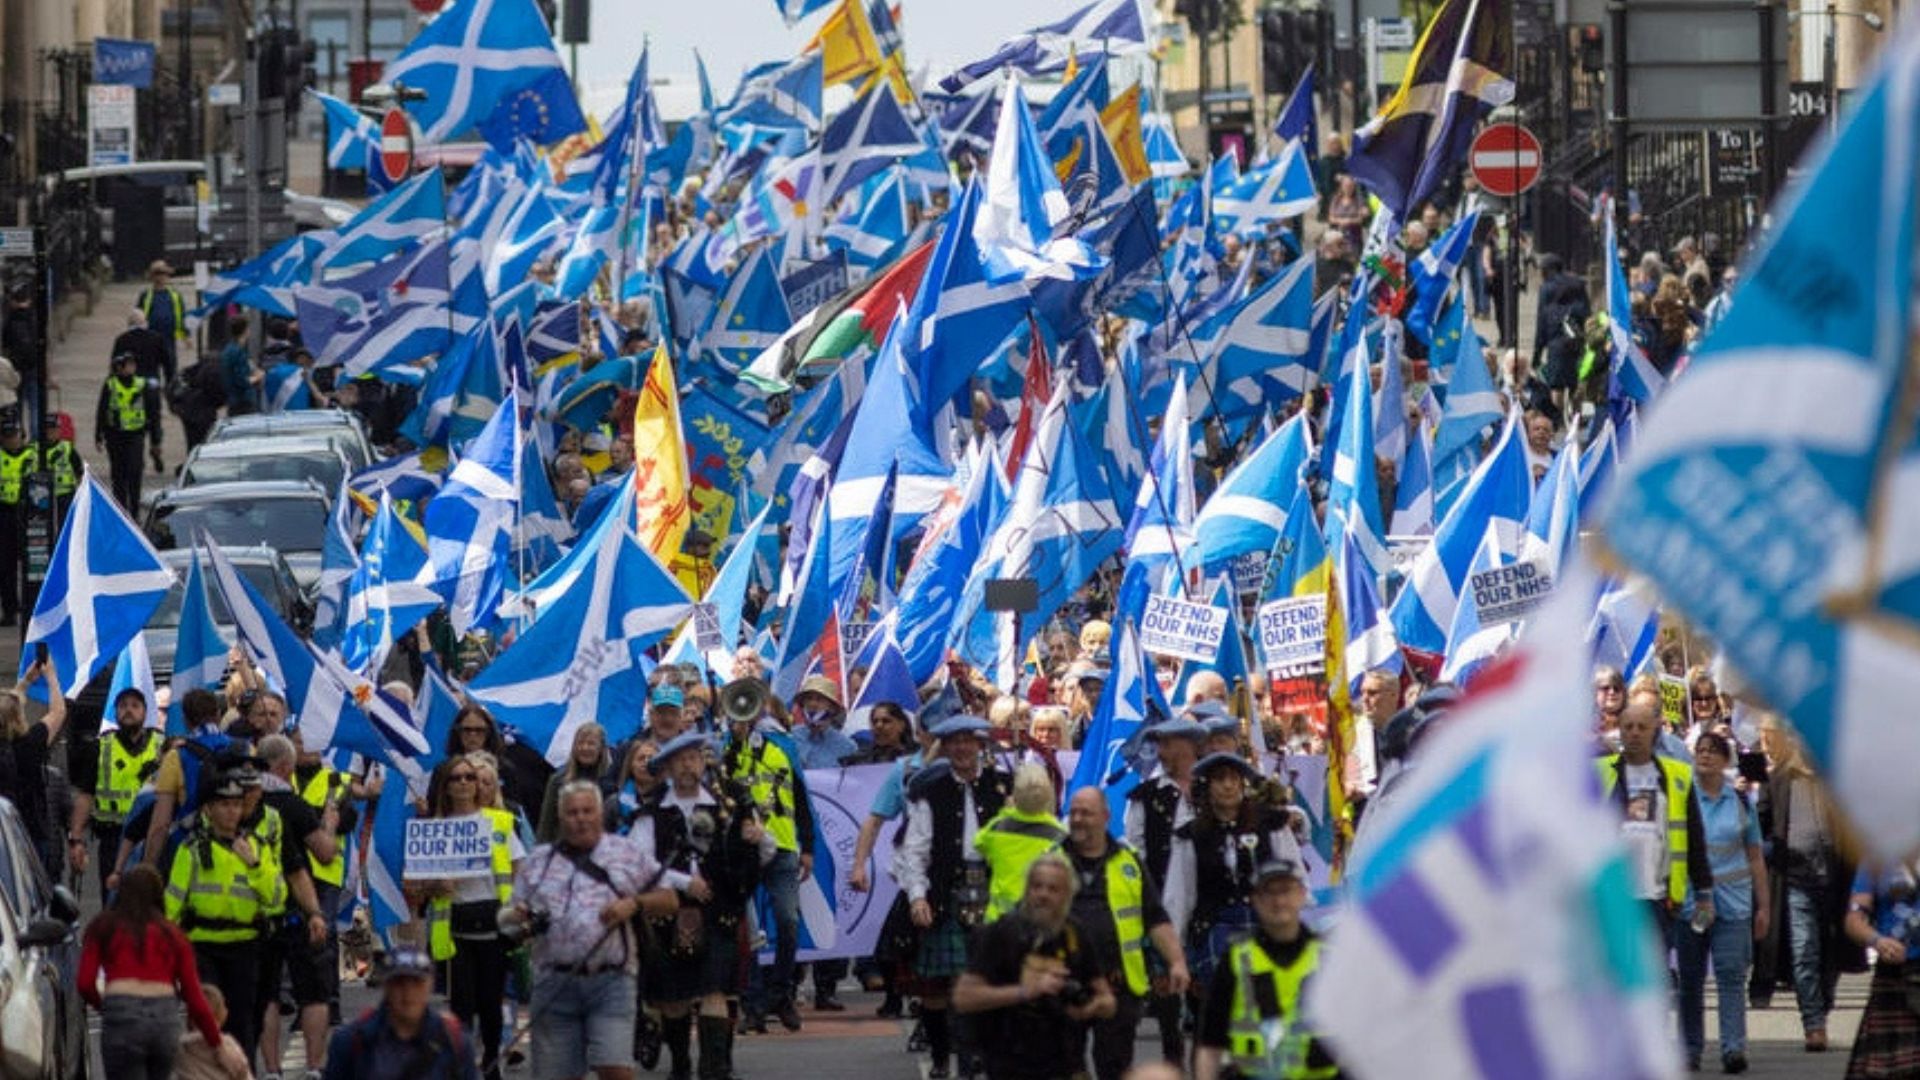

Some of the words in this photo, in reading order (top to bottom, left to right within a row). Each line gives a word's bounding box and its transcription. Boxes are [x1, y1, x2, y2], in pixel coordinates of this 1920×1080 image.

[1788, 90, 1826, 117] 204
[1472, 562, 1537, 591] DEFEND
[1475, 585, 1512, 608] OUR
[1516, 574, 1553, 599] NHS
[1150, 597, 1214, 624] DEFEND
[1263, 604, 1320, 631] DEFEND
[1145, 612, 1181, 633] OUR
[1184, 621, 1220, 643] NHS
[1264, 625, 1297, 647] OUR
[409, 821, 479, 838] DEFEND
[408, 838, 447, 856] OUR
[452, 836, 490, 855] NHS
